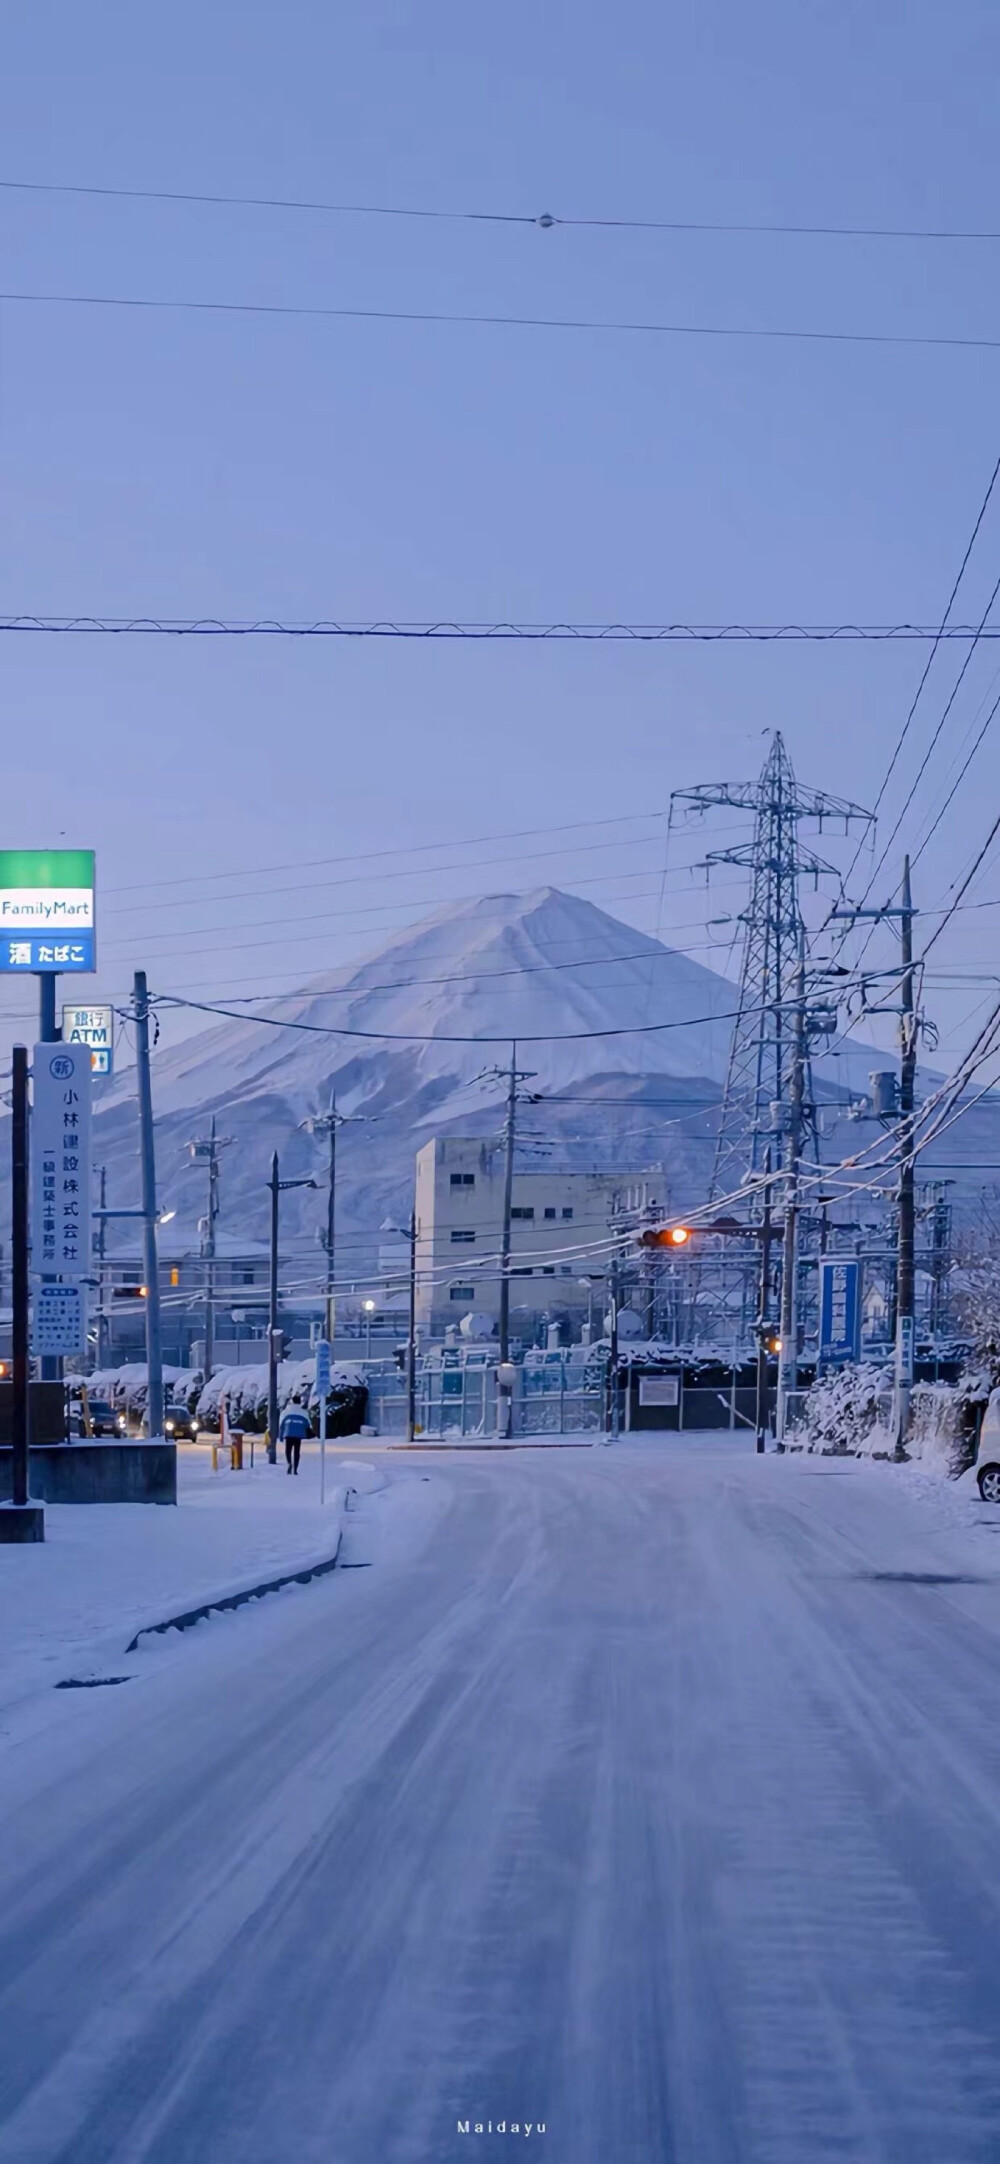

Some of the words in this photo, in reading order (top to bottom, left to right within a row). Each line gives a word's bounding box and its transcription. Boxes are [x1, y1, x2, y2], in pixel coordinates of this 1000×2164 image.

[2, 901, 89, 918] FamilyMart
[9, 943, 32, 965] 酒
[39, 945, 84, 962] たばこ
[74, 1011, 104, 1026] 銀行
[70, 1029, 107, 1043] ATM
